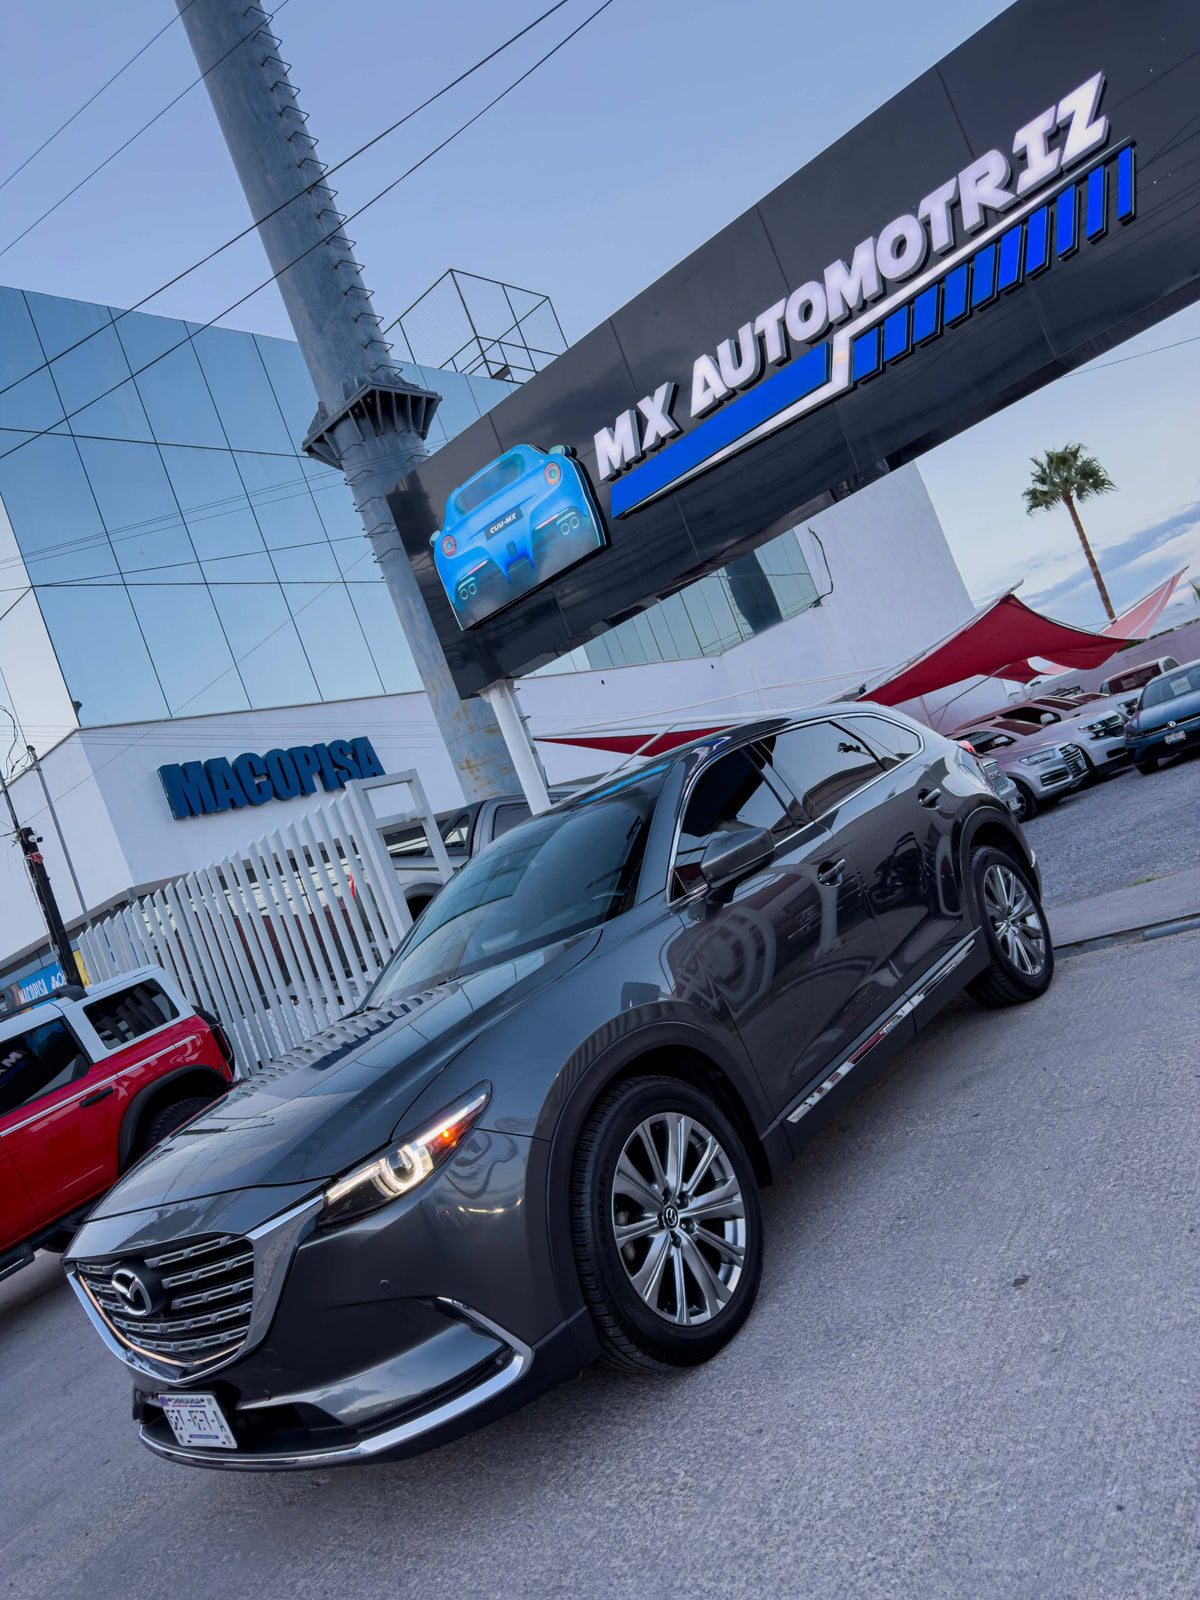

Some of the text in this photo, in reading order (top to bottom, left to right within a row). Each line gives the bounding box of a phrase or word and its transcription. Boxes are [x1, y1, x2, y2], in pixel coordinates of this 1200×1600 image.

[594, 71, 1110, 481] MX AUTOMOTRIZ
[157, 736, 386, 820] MACOPISA
